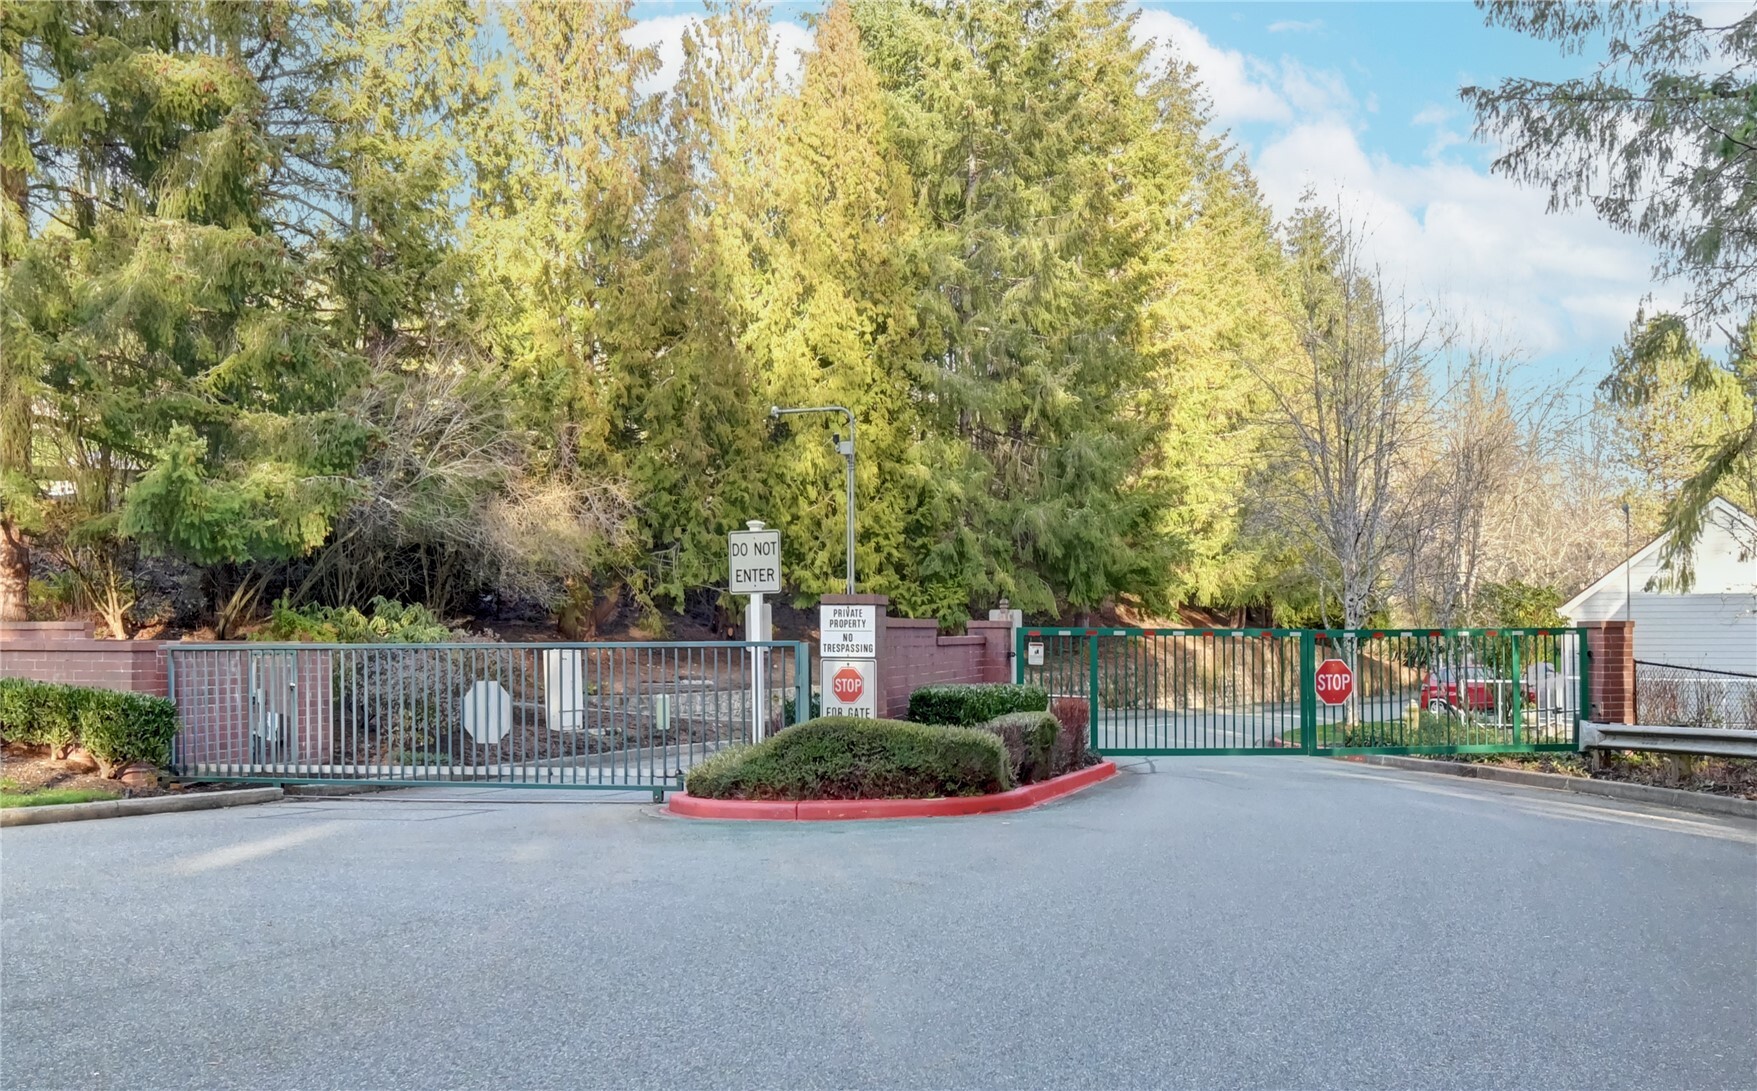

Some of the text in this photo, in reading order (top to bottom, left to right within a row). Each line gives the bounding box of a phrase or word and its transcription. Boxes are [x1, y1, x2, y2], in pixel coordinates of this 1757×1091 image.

[732, 541, 777, 557] DO NOT
[735, 568, 775, 583] ENTER
[833, 608, 863, 618] PRIVATE
[829, 619, 867, 629] PROPERTY
[842, 633, 854, 642] NO
[823, 644, 873, 653] TRESPASSING
[834, 679, 862, 693] STOP
[1317, 673, 1350, 691] STOP
[826, 707, 871, 718] FOR GATE
